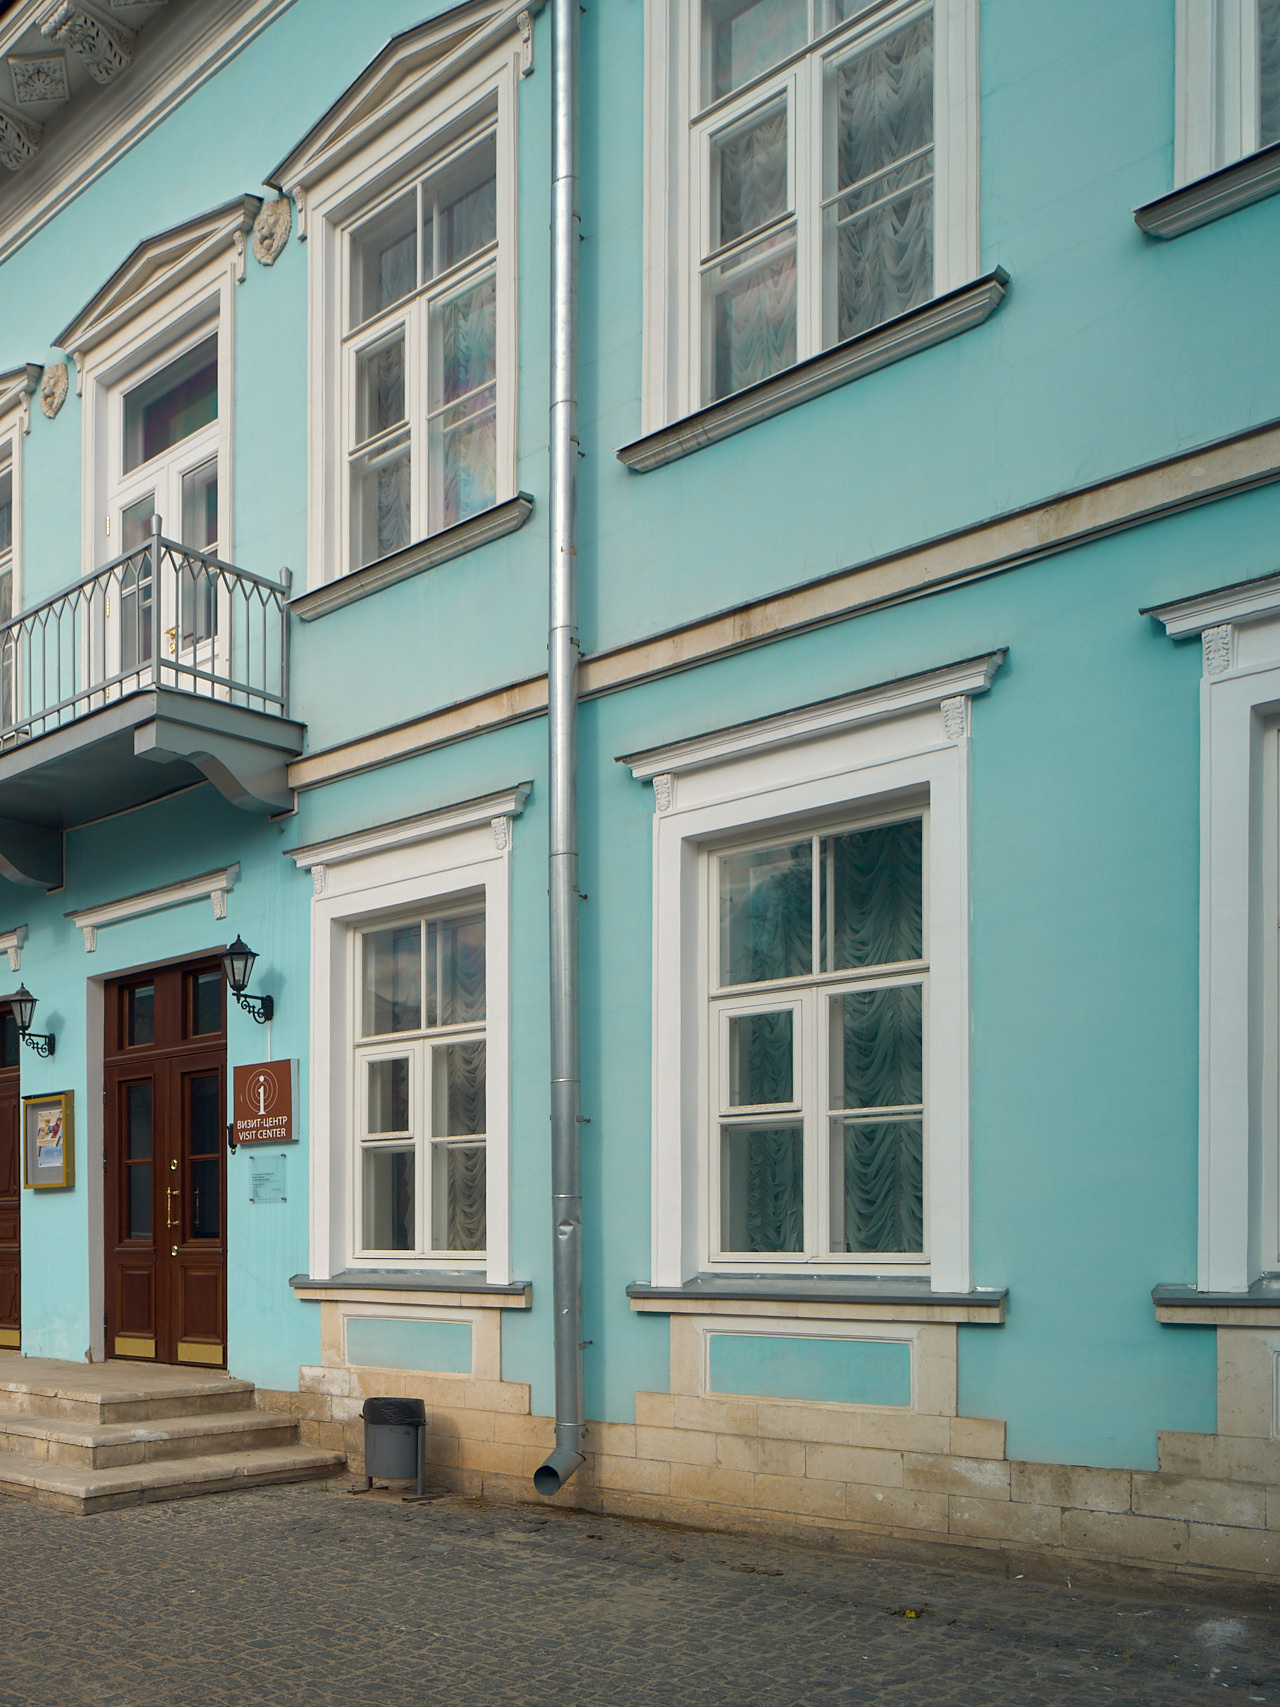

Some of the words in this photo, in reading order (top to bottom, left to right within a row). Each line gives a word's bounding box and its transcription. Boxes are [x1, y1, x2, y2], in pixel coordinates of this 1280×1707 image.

[237, 1116, 288, 1130] ВИЗИТ-ЦЕНТР
[238, 1131, 257, 1140] VISIT
[257, 1128, 286, 1139] CENTER
